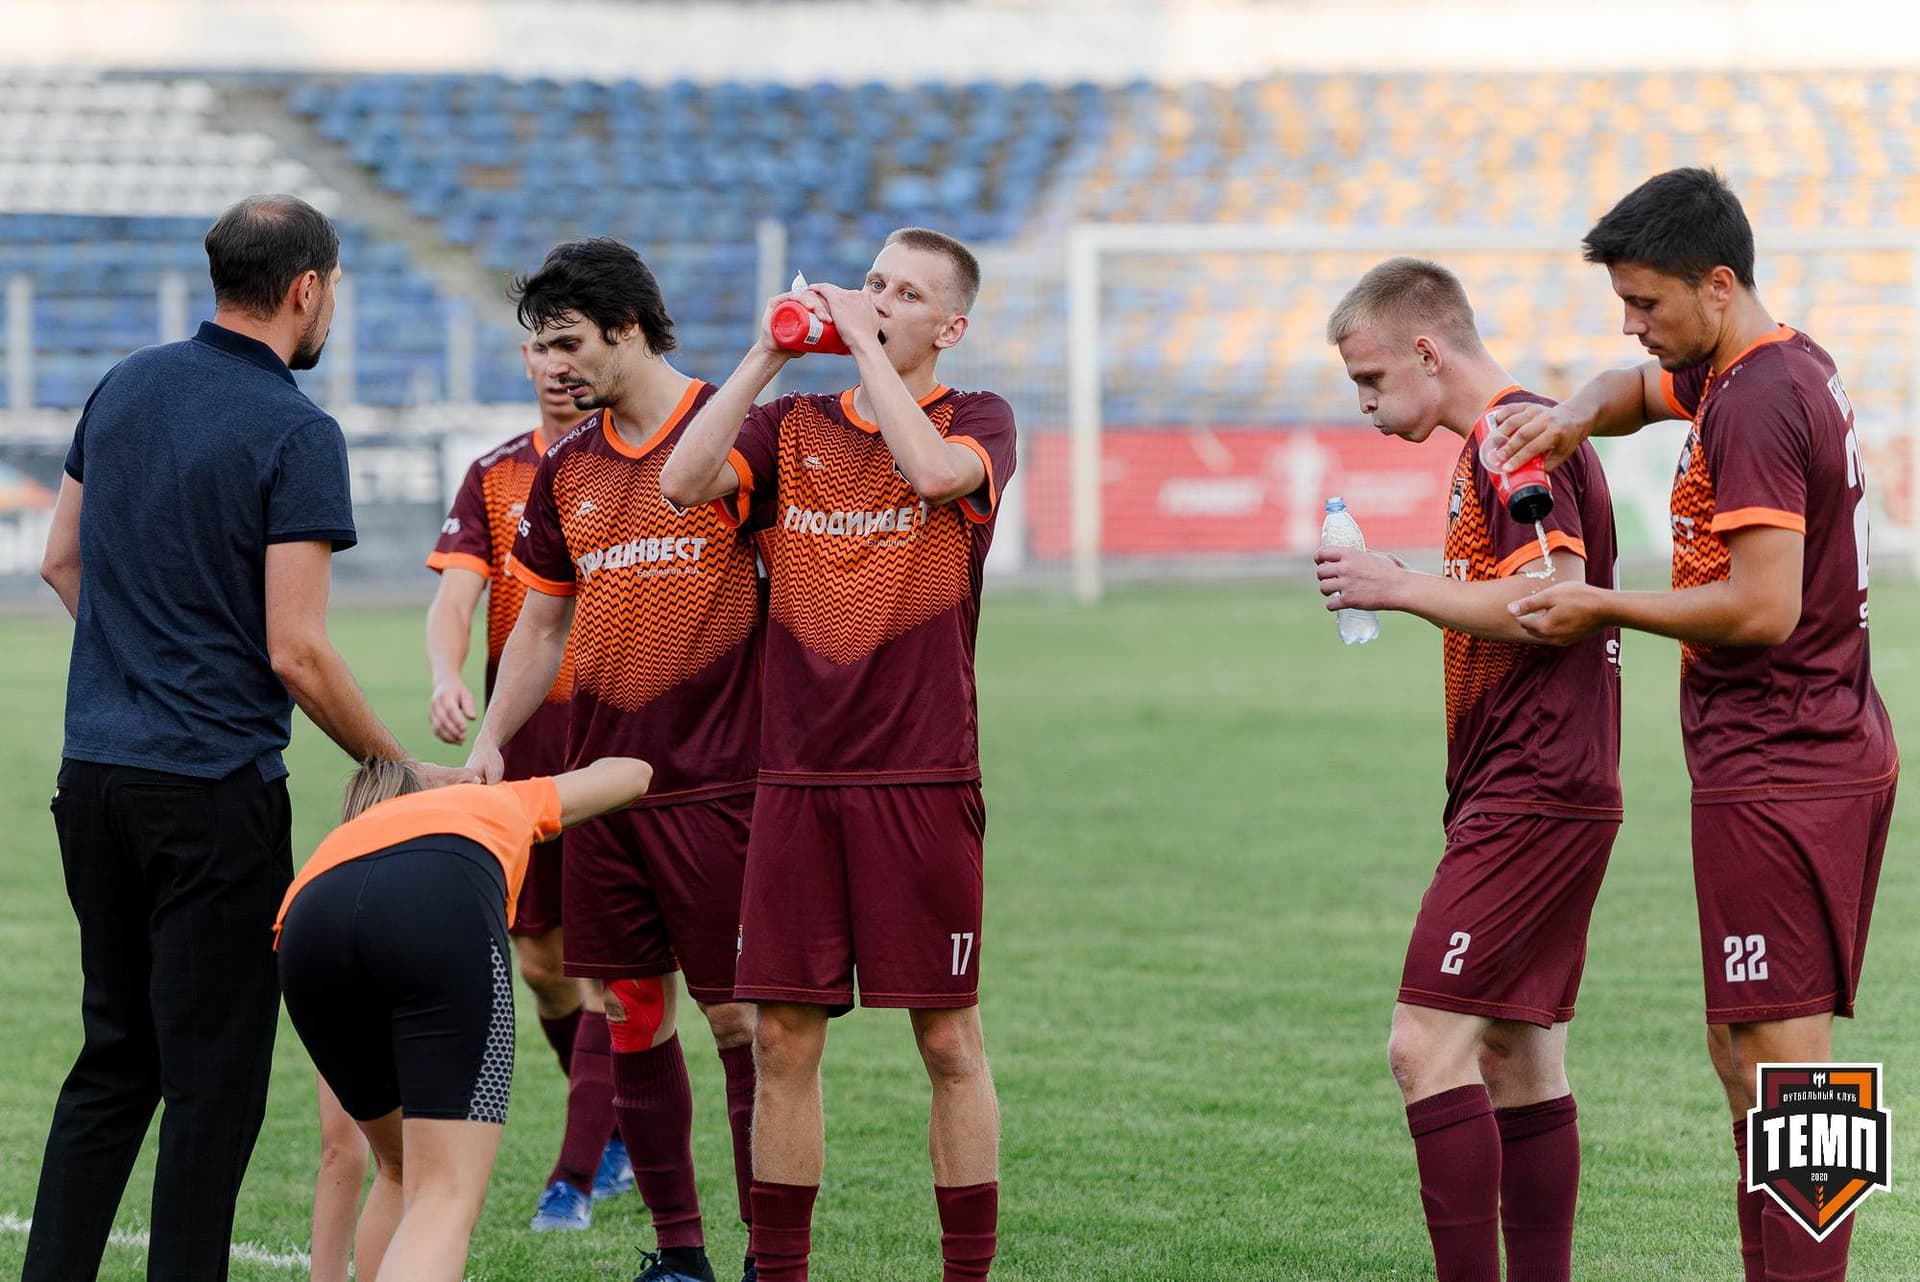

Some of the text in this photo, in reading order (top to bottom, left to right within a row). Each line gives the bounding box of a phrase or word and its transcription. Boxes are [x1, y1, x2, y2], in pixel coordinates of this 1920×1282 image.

[784, 501, 928, 537] ПРОДИНВЕТ
[950, 932, 974, 975] 17
[1440, 931, 1472, 975] 2
[1723, 934, 1769, 982] 22
